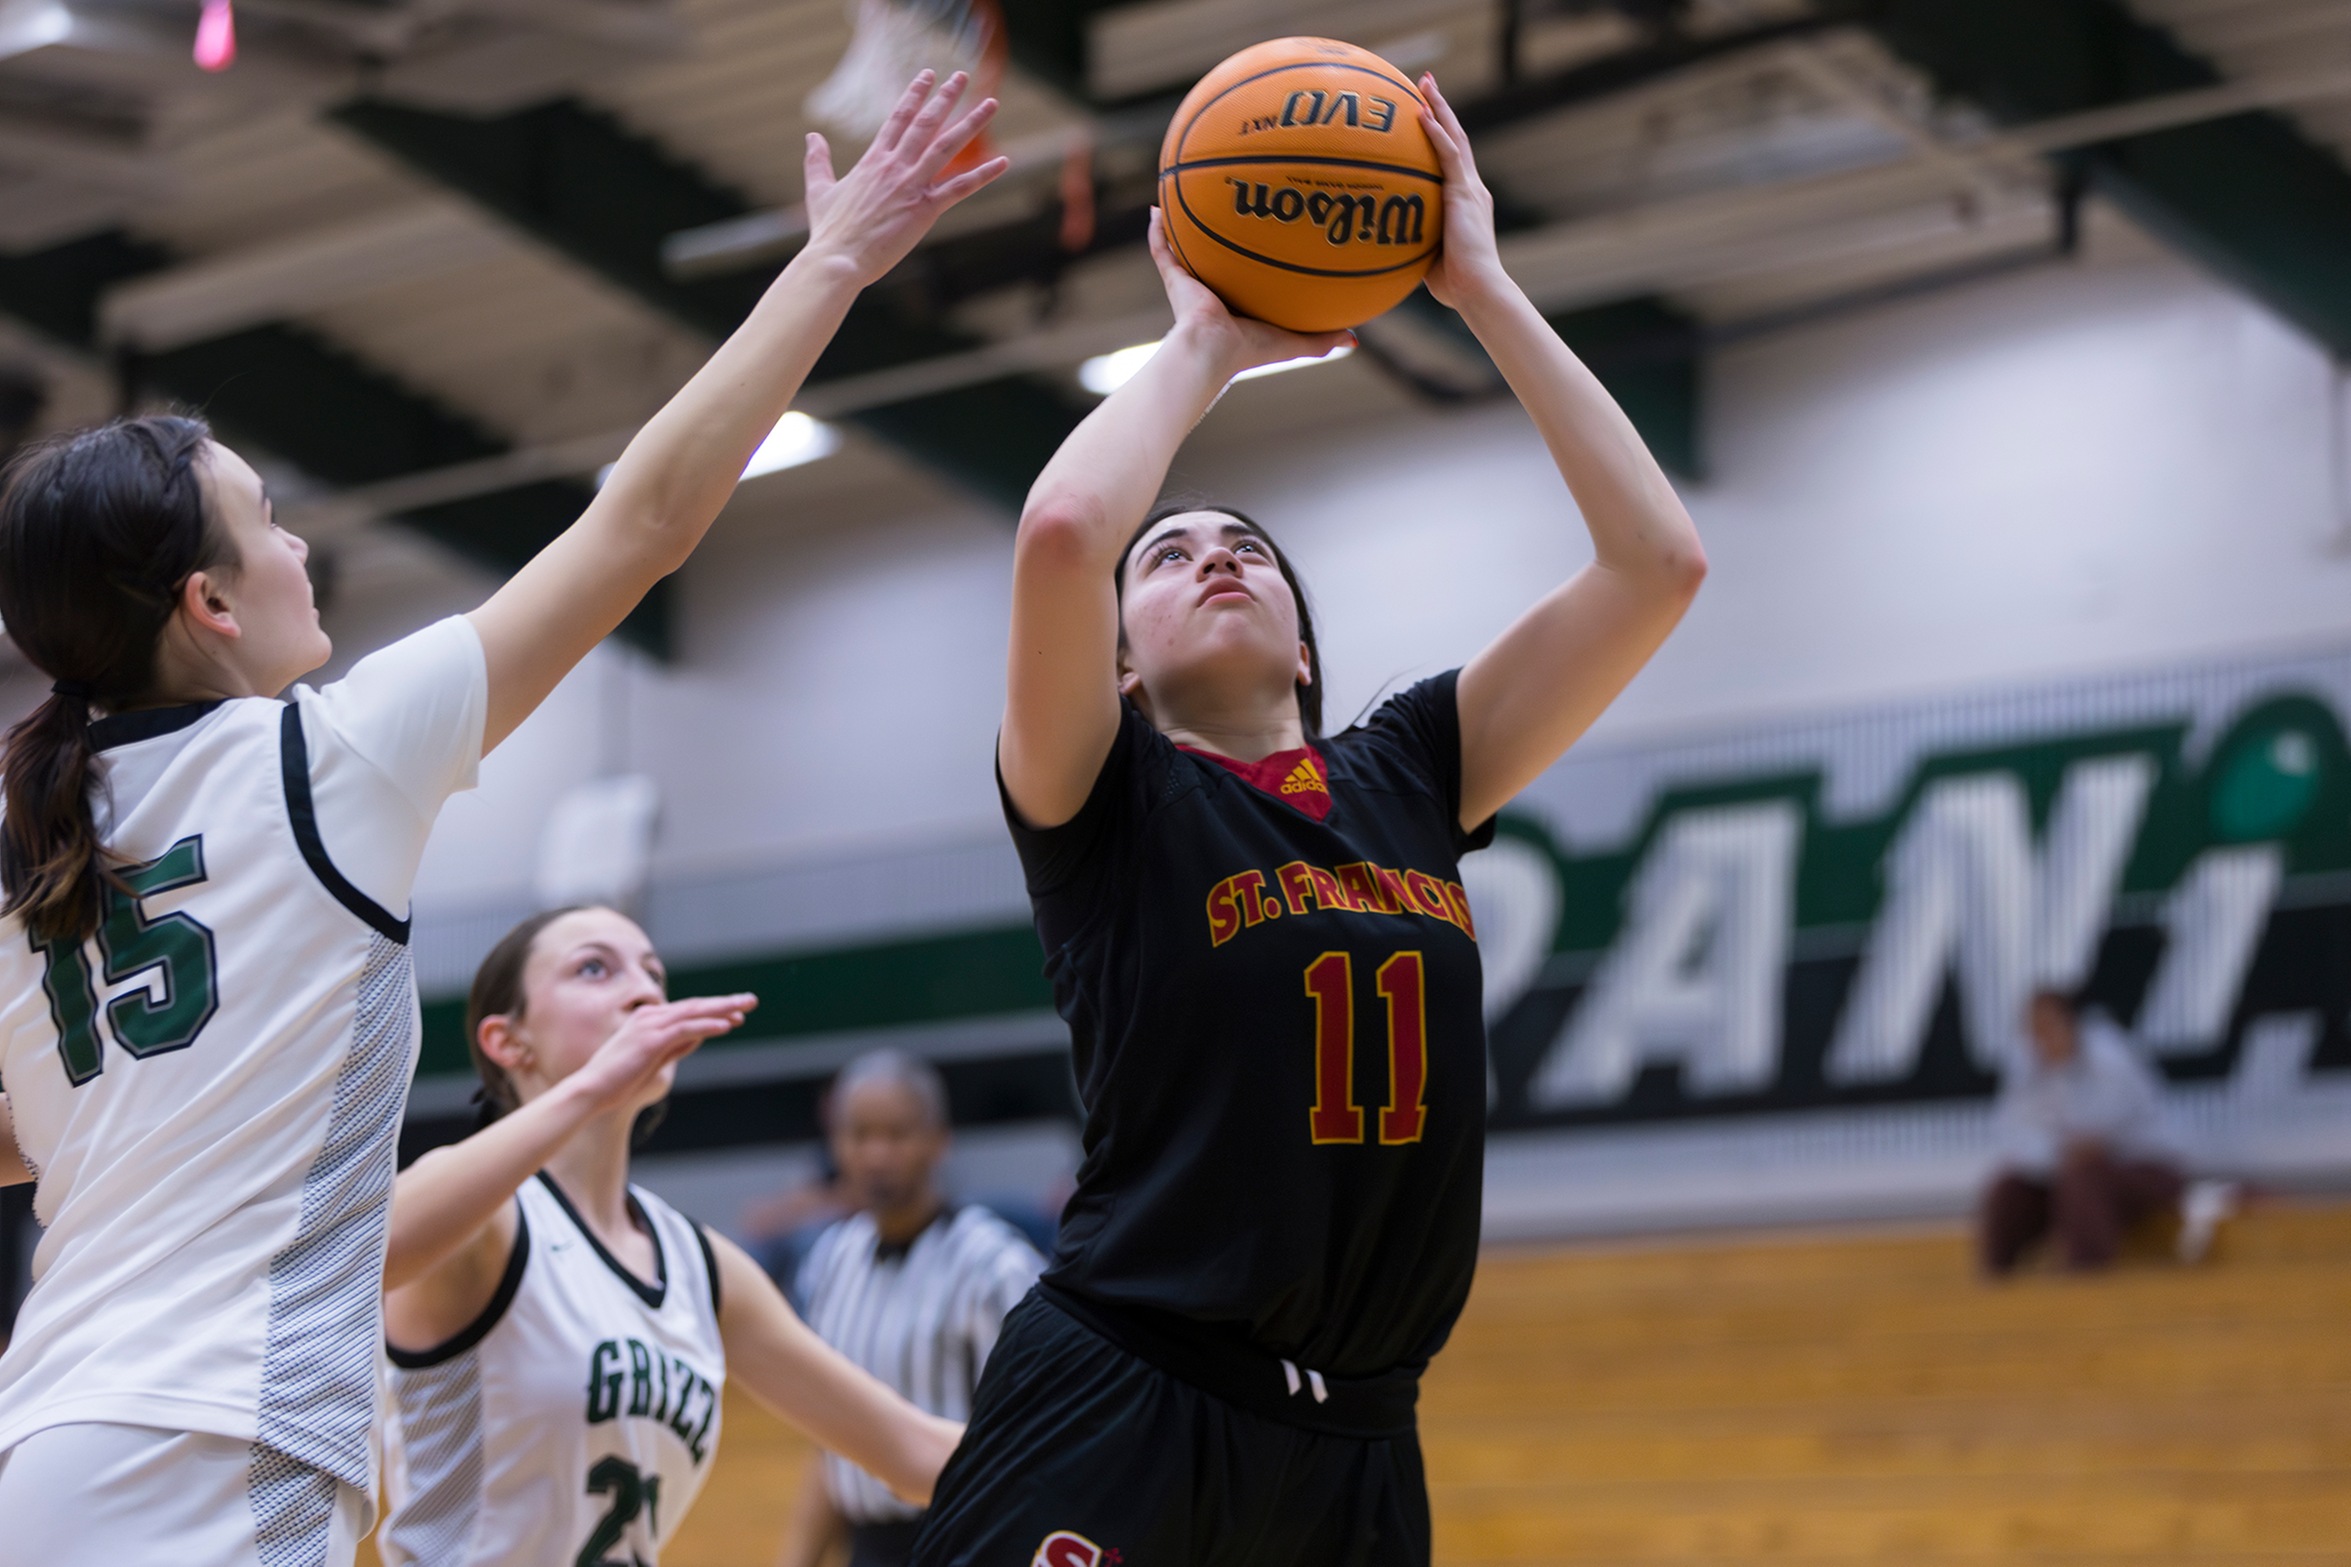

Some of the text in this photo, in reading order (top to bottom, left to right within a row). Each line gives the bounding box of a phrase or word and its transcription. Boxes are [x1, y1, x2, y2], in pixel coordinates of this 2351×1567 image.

[1280, 89, 1397, 133] EVO
[1234, 177, 1425, 246] Wilson
[1206, 869, 1282, 948] ST.
[28, 833, 219, 1088] 15
[1304, 951, 1428, 1146] 11
